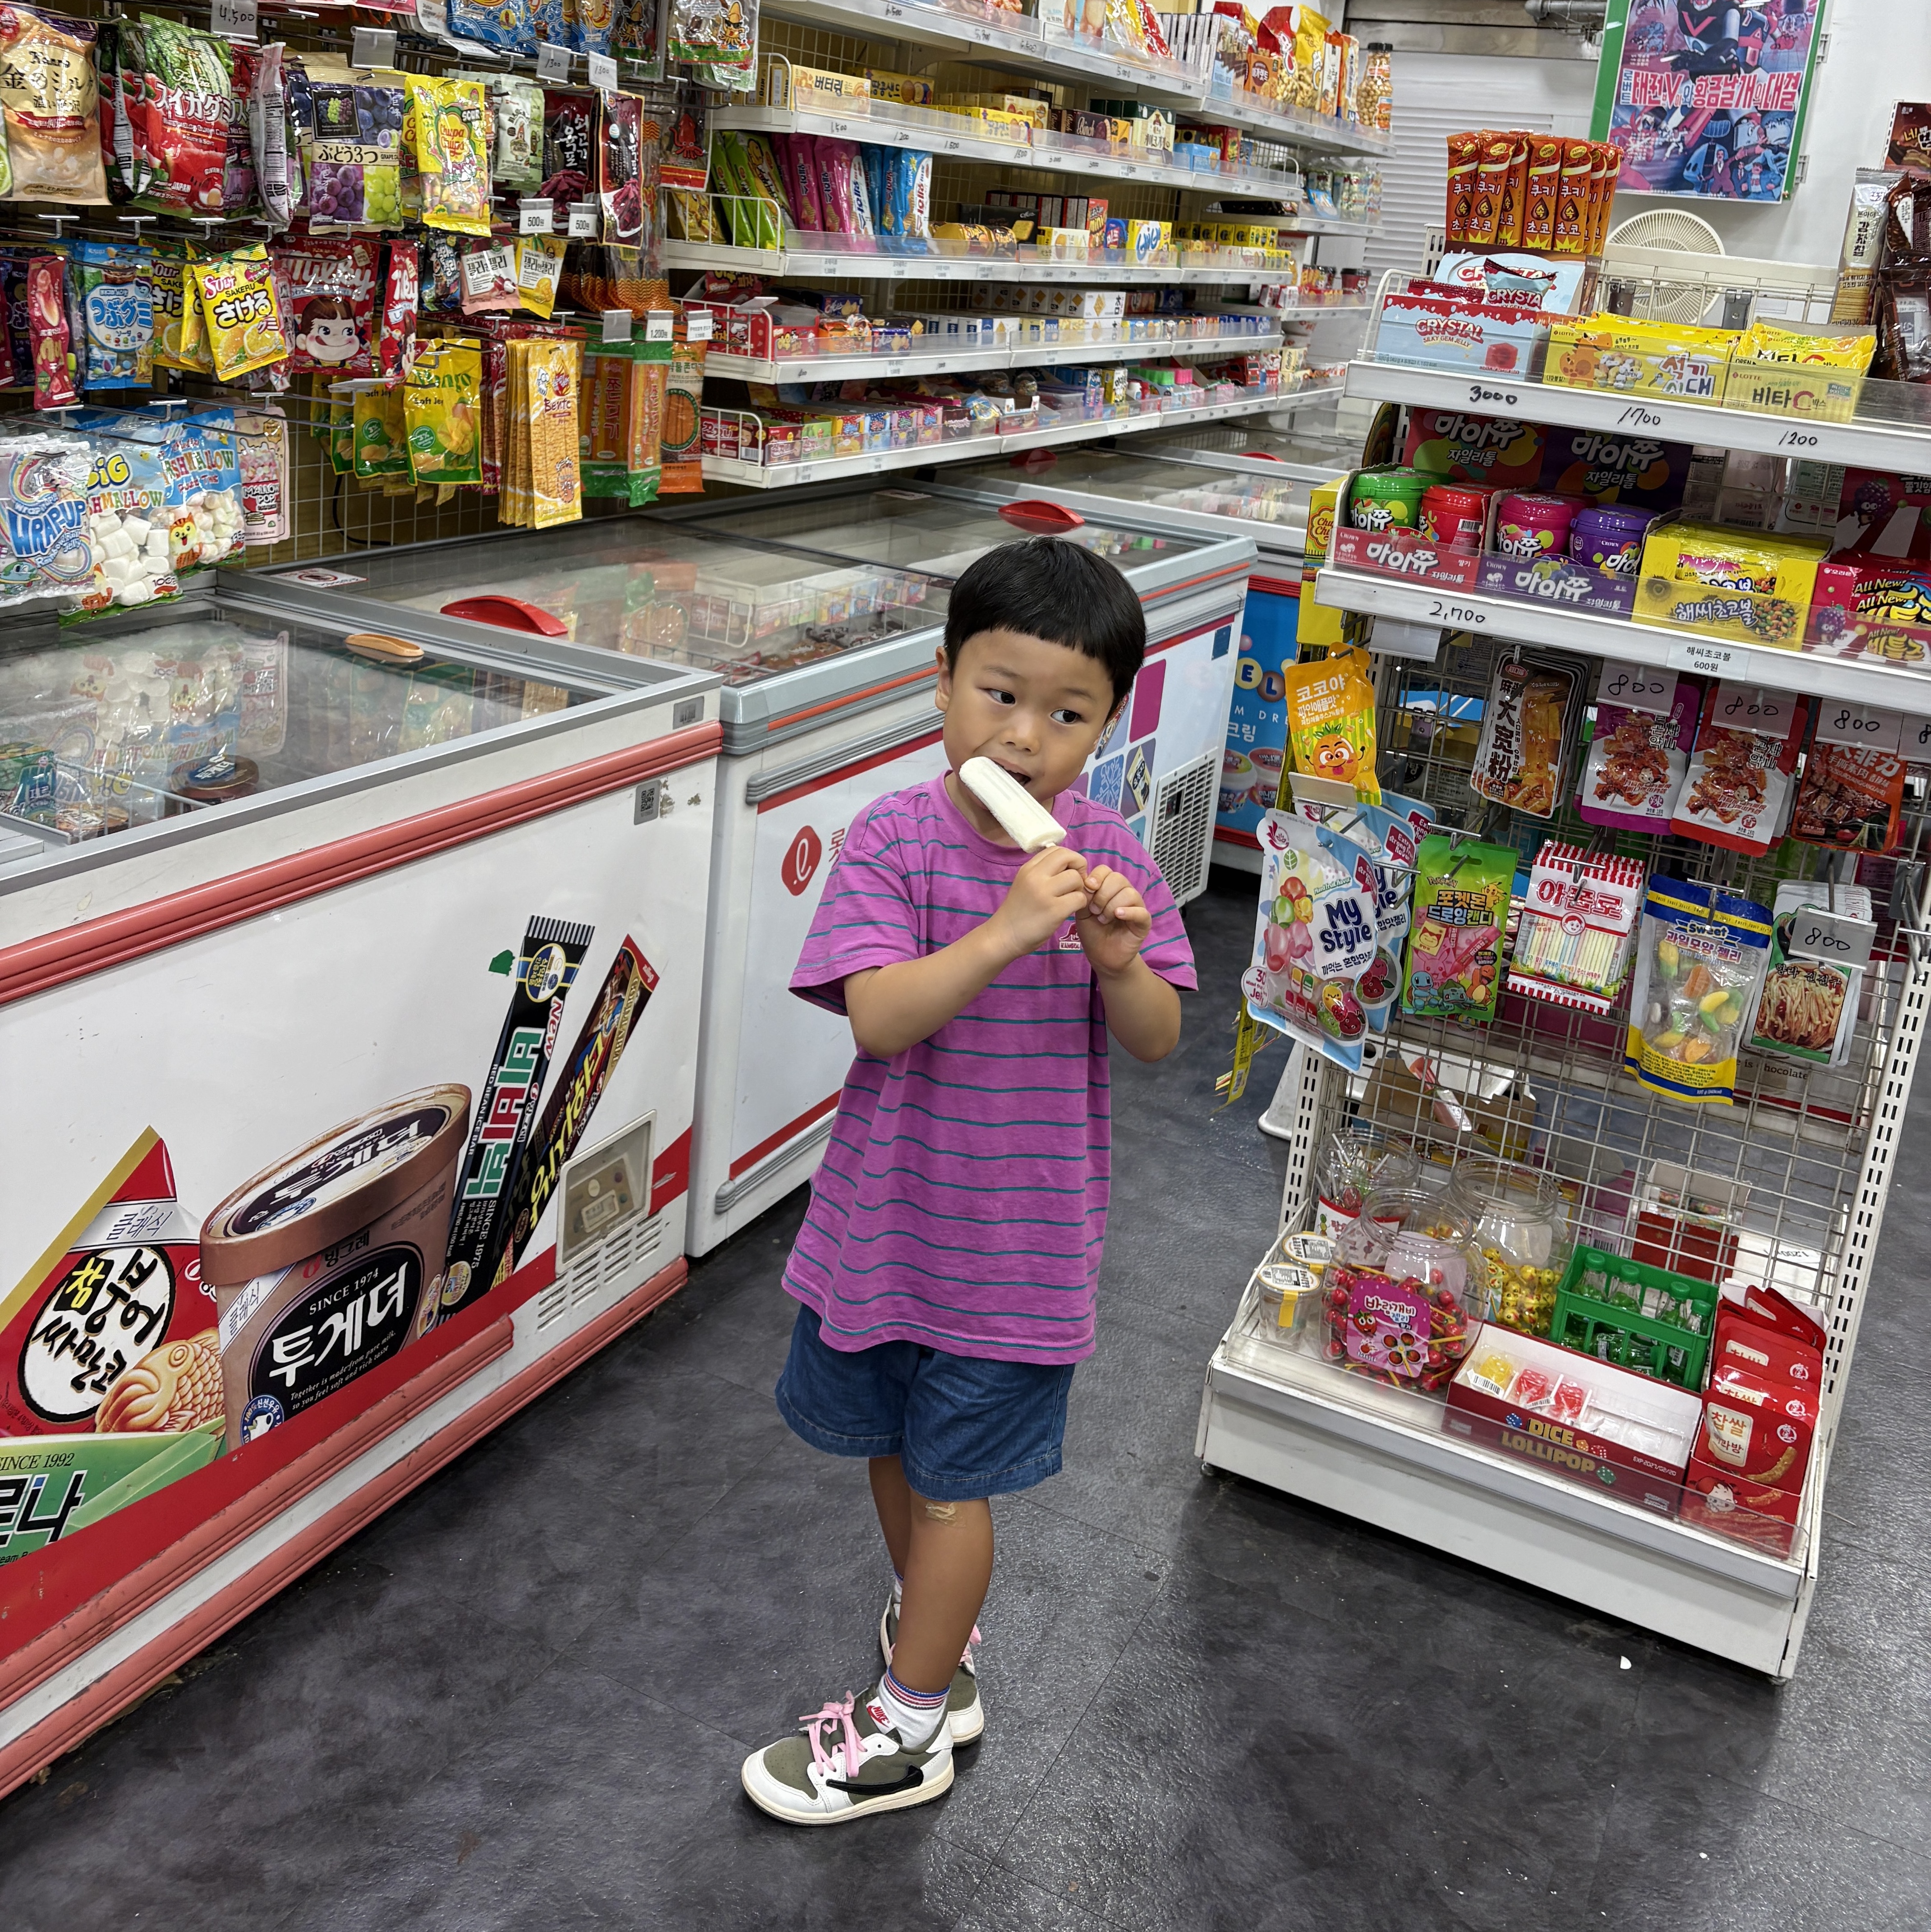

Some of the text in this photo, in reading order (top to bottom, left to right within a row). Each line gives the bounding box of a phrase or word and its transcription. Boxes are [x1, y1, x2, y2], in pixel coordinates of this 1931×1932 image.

[545, 59, 561, 68] 1300
[595, 66, 610, 75] 1300
[814, 75, 843, 96] 버터링
[462, 109, 480, 122] SOUR
[440, 124, 464, 138] Chupa
[318, 144, 378, 163] ぶどう3つ
[1478, 182, 1500, 195] 쿠키
[1531, 185, 1555, 197] 쿠키
[1561, 185, 1585, 197] 쿠키
[1470, 218, 1492, 232] 초코
[1527, 221, 1550, 234] 초코
[1557, 223, 1580, 235] 초코
[205, 275, 237, 299] Sour
[225, 283, 255, 298] SAKERU
[90, 296, 154, 329] つぶグミ
[214, 290, 272, 328] さける
[257, 315, 279, 334] グミ
[1416, 318, 1484, 344] CRYSTAL
[1423, 335, 1440, 344] SILKY
[1454, 338, 1471, 348] JELLY
[1659, 354, 1707, 380] 석기
[1469, 385, 1518, 405] 3000
[1665, 376, 1713, 396] 시대
[1752, 387, 1827, 411] 비타C 박스
[1617, 407, 1661, 426] 1700
[1434, 413, 1524, 449] 마이쮸
[1778, 431, 1818, 445] 1200
[1447, 449, 1497, 468] 자일리톨
[1571, 434, 1665, 472] 마이쮸
[1586, 469, 1639, 490] 자일리톨
[243, 483, 280, 498] MALLOW
[258, 495, 276, 505] POP
[1340, 532, 1359, 542] CROWN
[1367, 542, 1439, 575] 마이쮸
[1458, 559, 1471, 567] 딸기
[1486, 561, 1507, 571] CROWN
[1432, 571, 1465, 583] 자일리톨
[1515, 571, 1593, 602] 마이쮸
[1854, 581, 1872, 594] All
[1429, 601, 1486, 624] 2,700
[1586, 598, 1622, 610] 자일리톨
[1675, 598, 1757, 627] 해씨초코볼
[1856, 598, 1876, 612] All
[1867, 630, 1881, 638] All
[1687, 646, 1732, 662] 해씨초코볼
[1694, 662, 1719, 673] 600원
[1297, 674, 1345, 703] 코코야
[1608, 674, 1665, 696] 800
[1725, 696, 1779, 716] 800
[1834, 710, 1881, 732] 800
[1742, 815, 1756, 827] 香
[1438, 890, 1487, 911] 포켓몬
[1537, 879, 1623, 921] 아폴로
[1324, 897, 1362, 929] My
[1428, 904, 1494, 926] 드로잉캔디
[1319, 923, 1372, 954] Style
[1689, 922, 1728, 937] Sweet
[1805, 927, 1851, 951] 800
[1665, 930, 1743, 964] 과일모양 젤리
[544, 996, 564, 1060] New
[463, 1025, 546, 1201] 비비빅
[469, 1062, 498, 1156] RED BEAN ICE BAR
[269, 1119, 420, 1205] 투게더
[106, 1211, 173, 1240] 클래식
[472, 1200, 498, 1269] SINCE 1975
[325, 1230, 370, 1268] 빙그레
[309, 1267, 379, 1316] SINCE 1974
[1364, 1295, 1417, 1316] 바람개비
[269, 1261, 408, 1387] 투게더
[32, 1315, 127, 1393] 싸만코
[291, 1381, 320, 1401] Together
[321, 1377, 327, 1386] is
[366, 1344, 380, 1359] pure
[381, 1330, 396, 1345] milk.
[292, 1345, 389, 1410] so you feel soft and rich taste
[1527, 1418, 1575, 1446] DICE
[1711, 1411, 1747, 1437] 찹쌀
[42, 1452, 75, 1470] 1992
[1501, 1431, 1596, 1473] LOLLIPOP
[1633, 1456, 1644, 1464] EXP
[874, 1706, 889, 1724] NIKE
